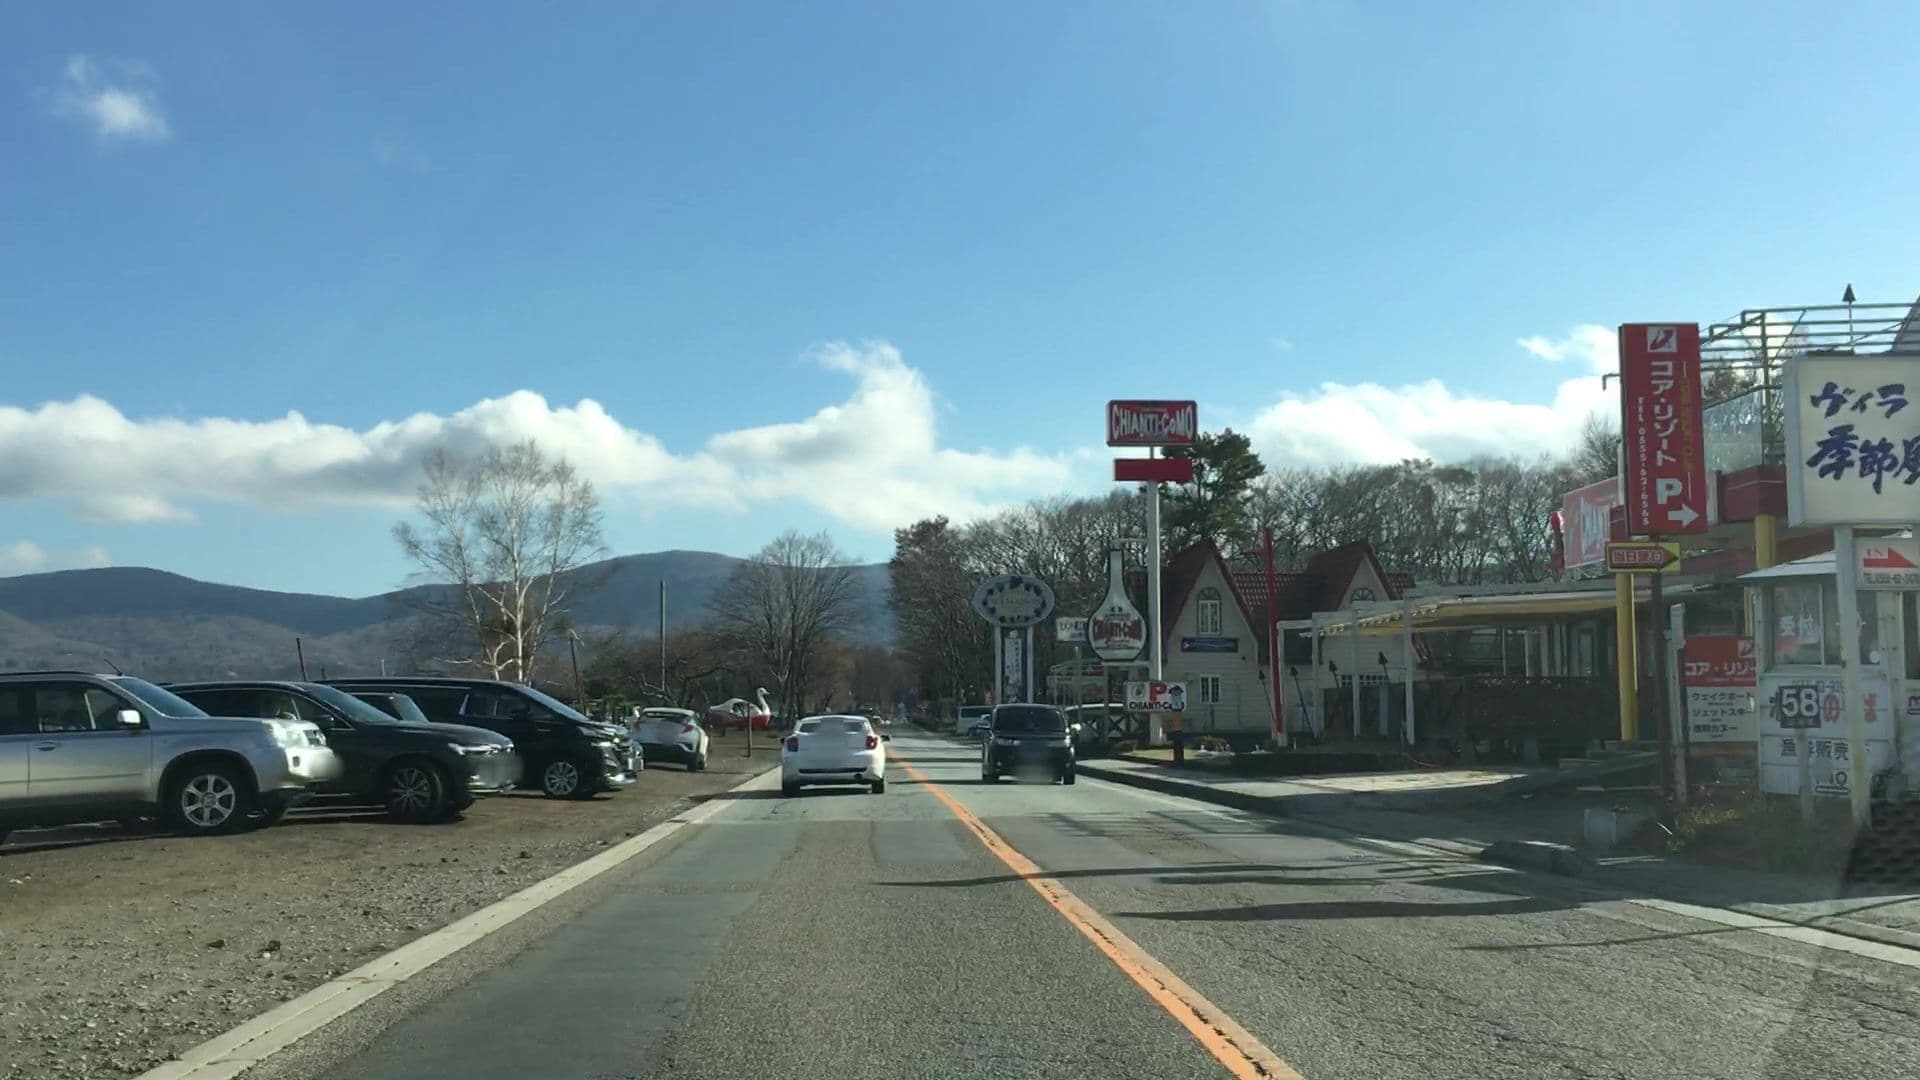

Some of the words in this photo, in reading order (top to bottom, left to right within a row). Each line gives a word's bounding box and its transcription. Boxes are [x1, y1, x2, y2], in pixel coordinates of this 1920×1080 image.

[1809, 381, 1909, 418] ヴィラ
[1655, 477, 1683, 505] P
[1149, 682, 1168, 702] P
[1781, 687, 1819, 718] 58
